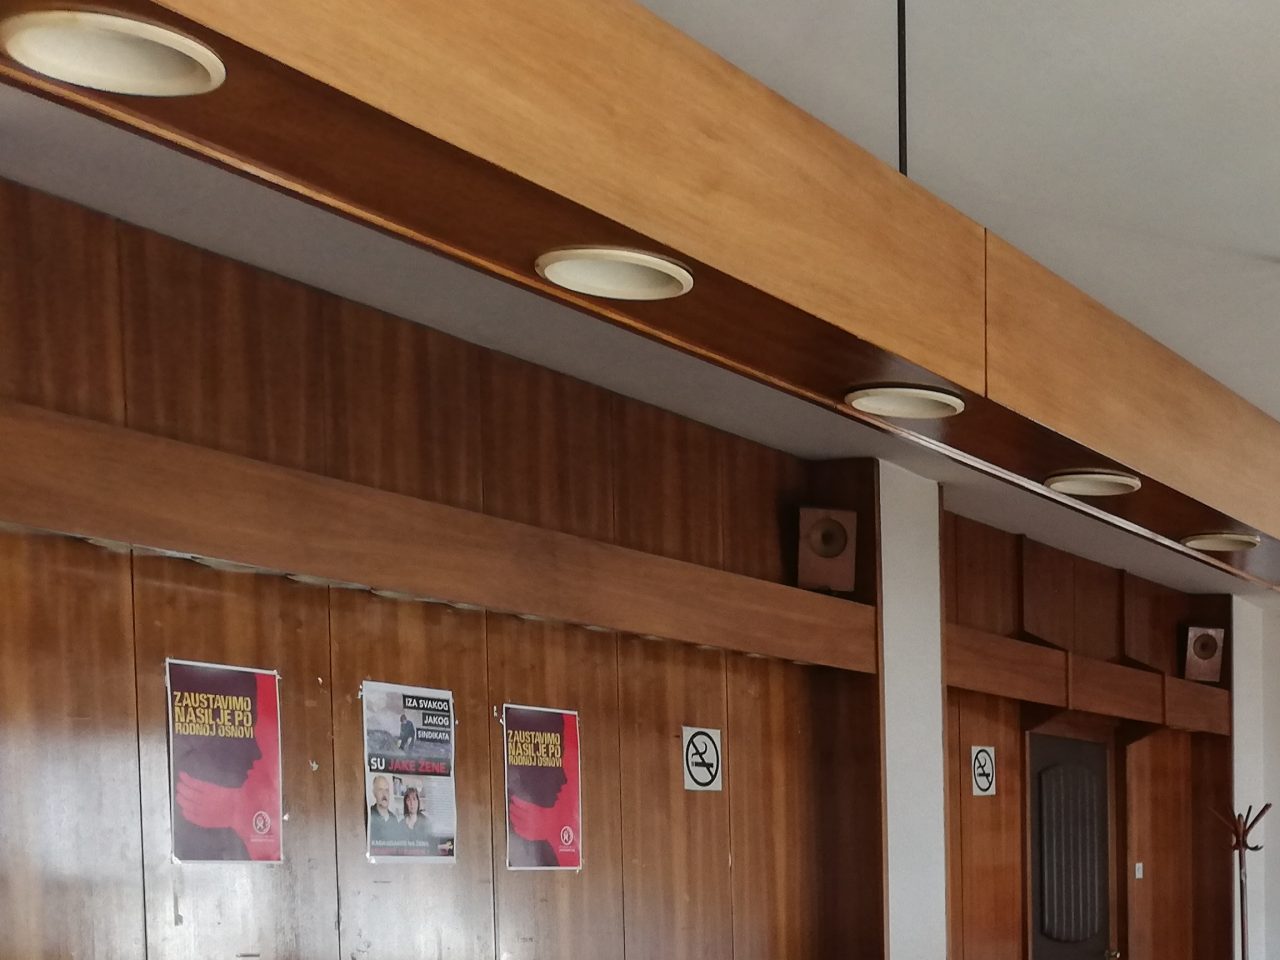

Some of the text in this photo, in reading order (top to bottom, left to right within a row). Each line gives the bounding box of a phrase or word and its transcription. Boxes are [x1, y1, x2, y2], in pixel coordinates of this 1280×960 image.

[173, 691, 252, 711] ZAUSTAVIMO
[405, 698, 449, 711] IZA SVAKOG
[174, 708, 253, 727] NASILJE PO
[423, 714, 450, 726] JAKOG
[175, 723, 254, 739] RODNOJ OSNOVI
[507, 730, 561, 745] ZAUSTAVIMO
[508, 743, 561, 758] NASILJE PO
[370, 757, 386, 770] SU
[508, 755, 562, 768] RODNOJ OSNOVI
